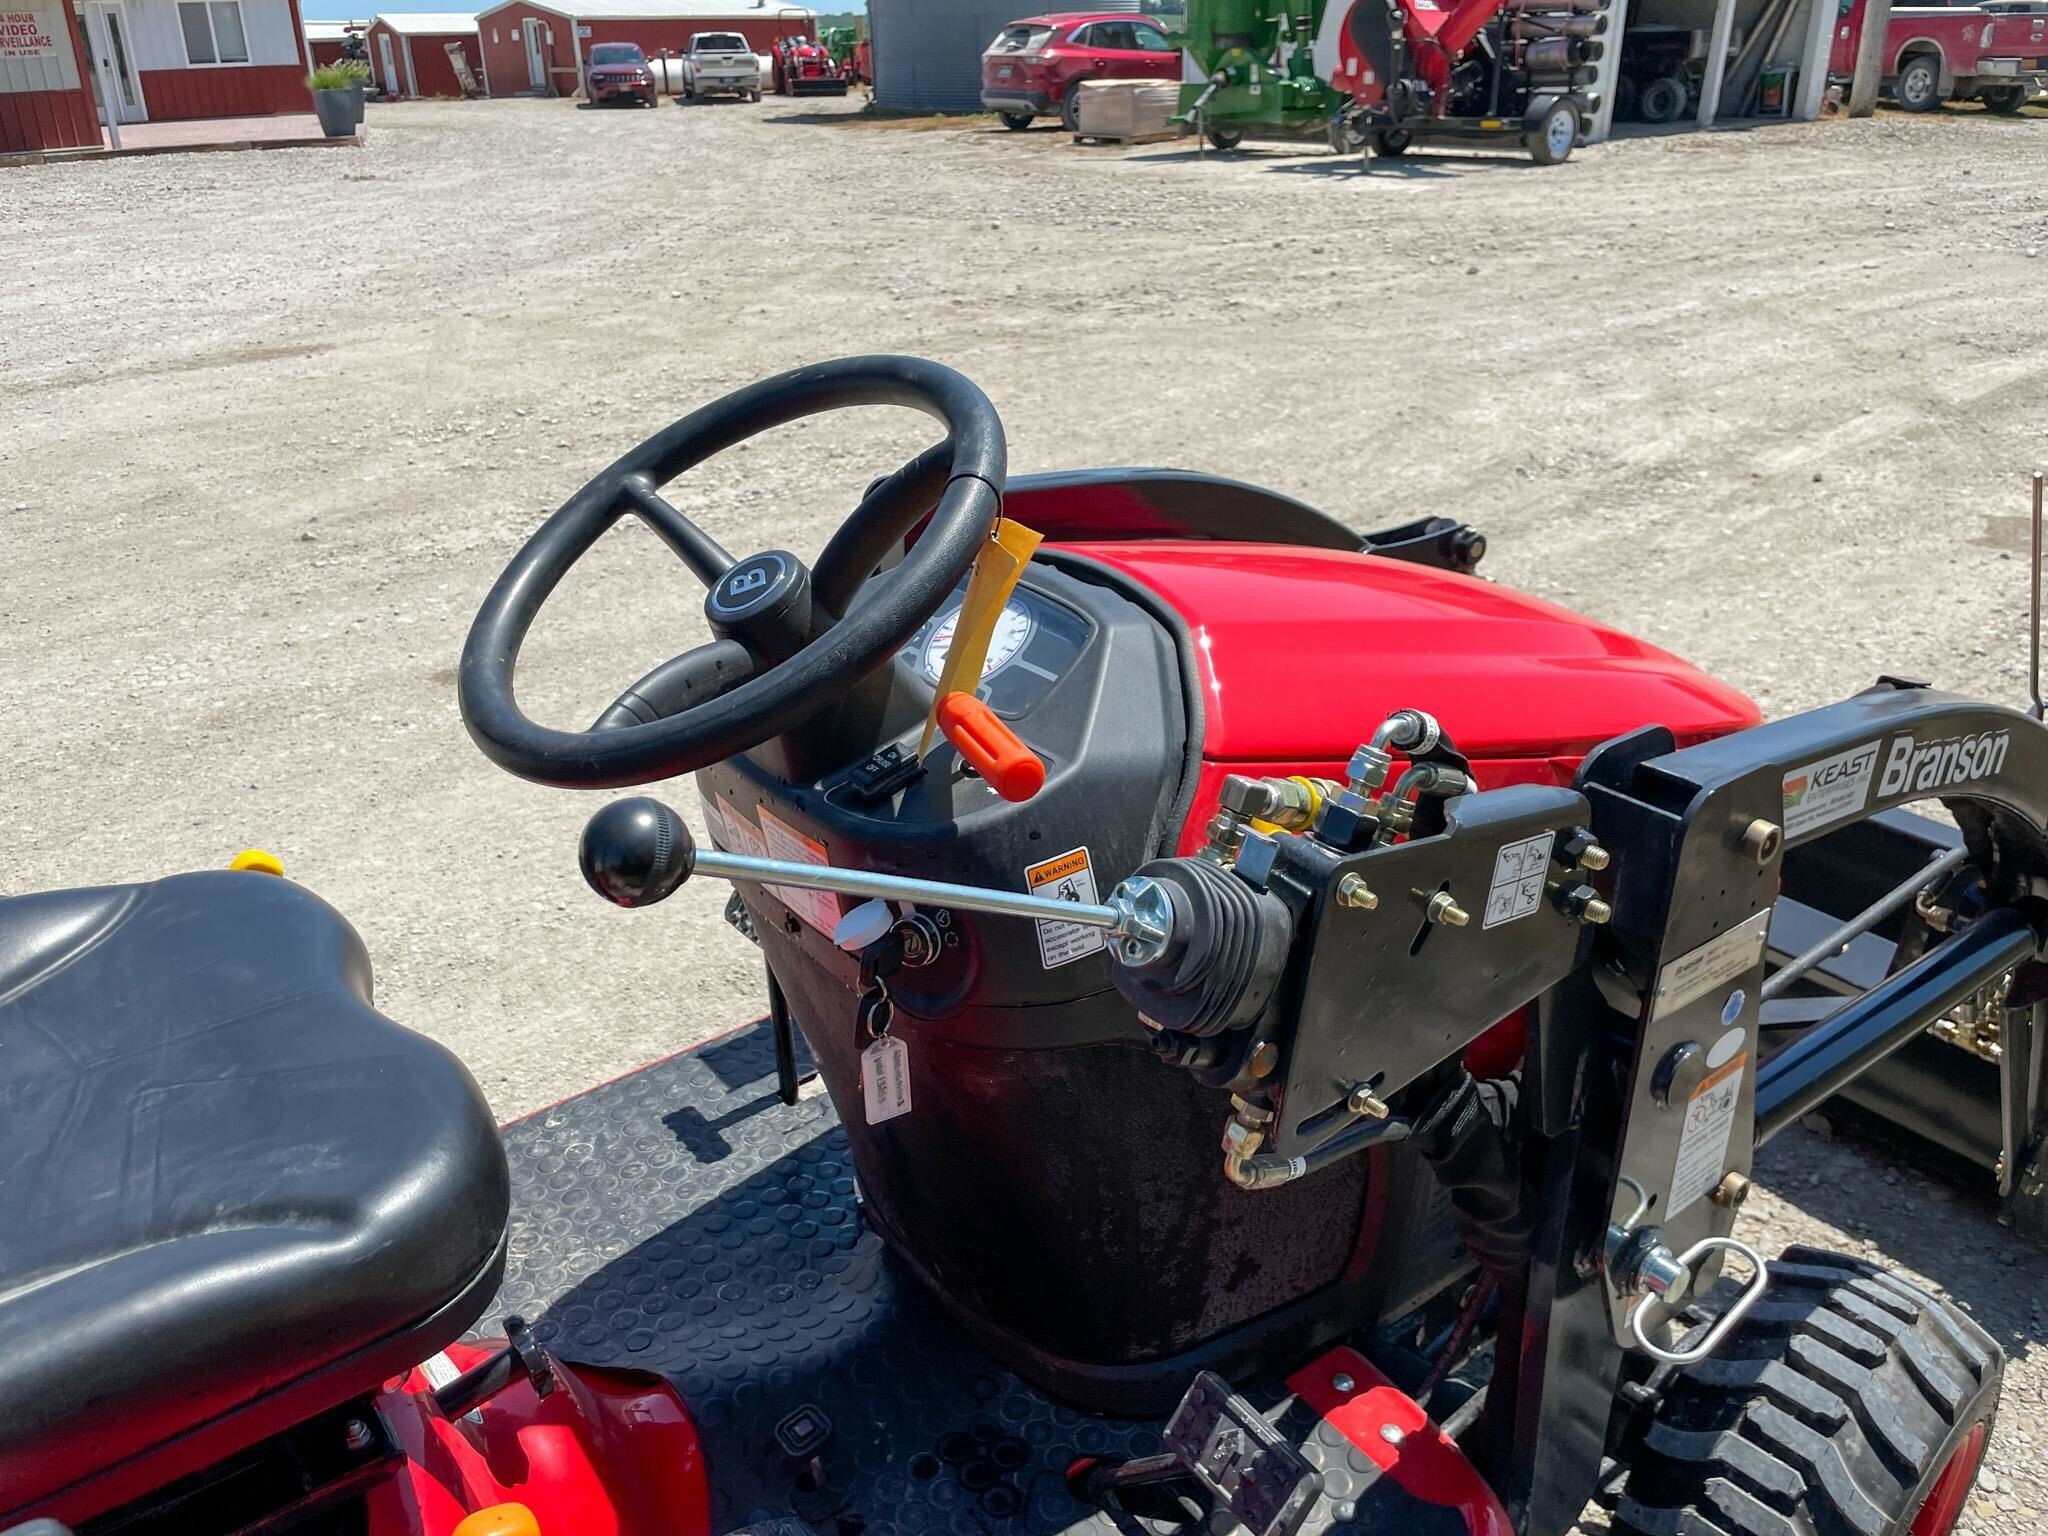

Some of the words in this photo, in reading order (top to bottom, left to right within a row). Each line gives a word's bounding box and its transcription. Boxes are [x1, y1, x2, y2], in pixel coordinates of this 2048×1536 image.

[7, 13, 36, 23] HOUR
[1810, 750, 1877, 791] KEAST
[1877, 735, 2010, 798] Branson
[1044, 856, 1085, 877] WARNING
[1044, 927, 1080, 943] accelerator
[1054, 922, 1065, 931] not
[1046, 940, 1069, 952] except
[1070, 930, 1096, 944] working
